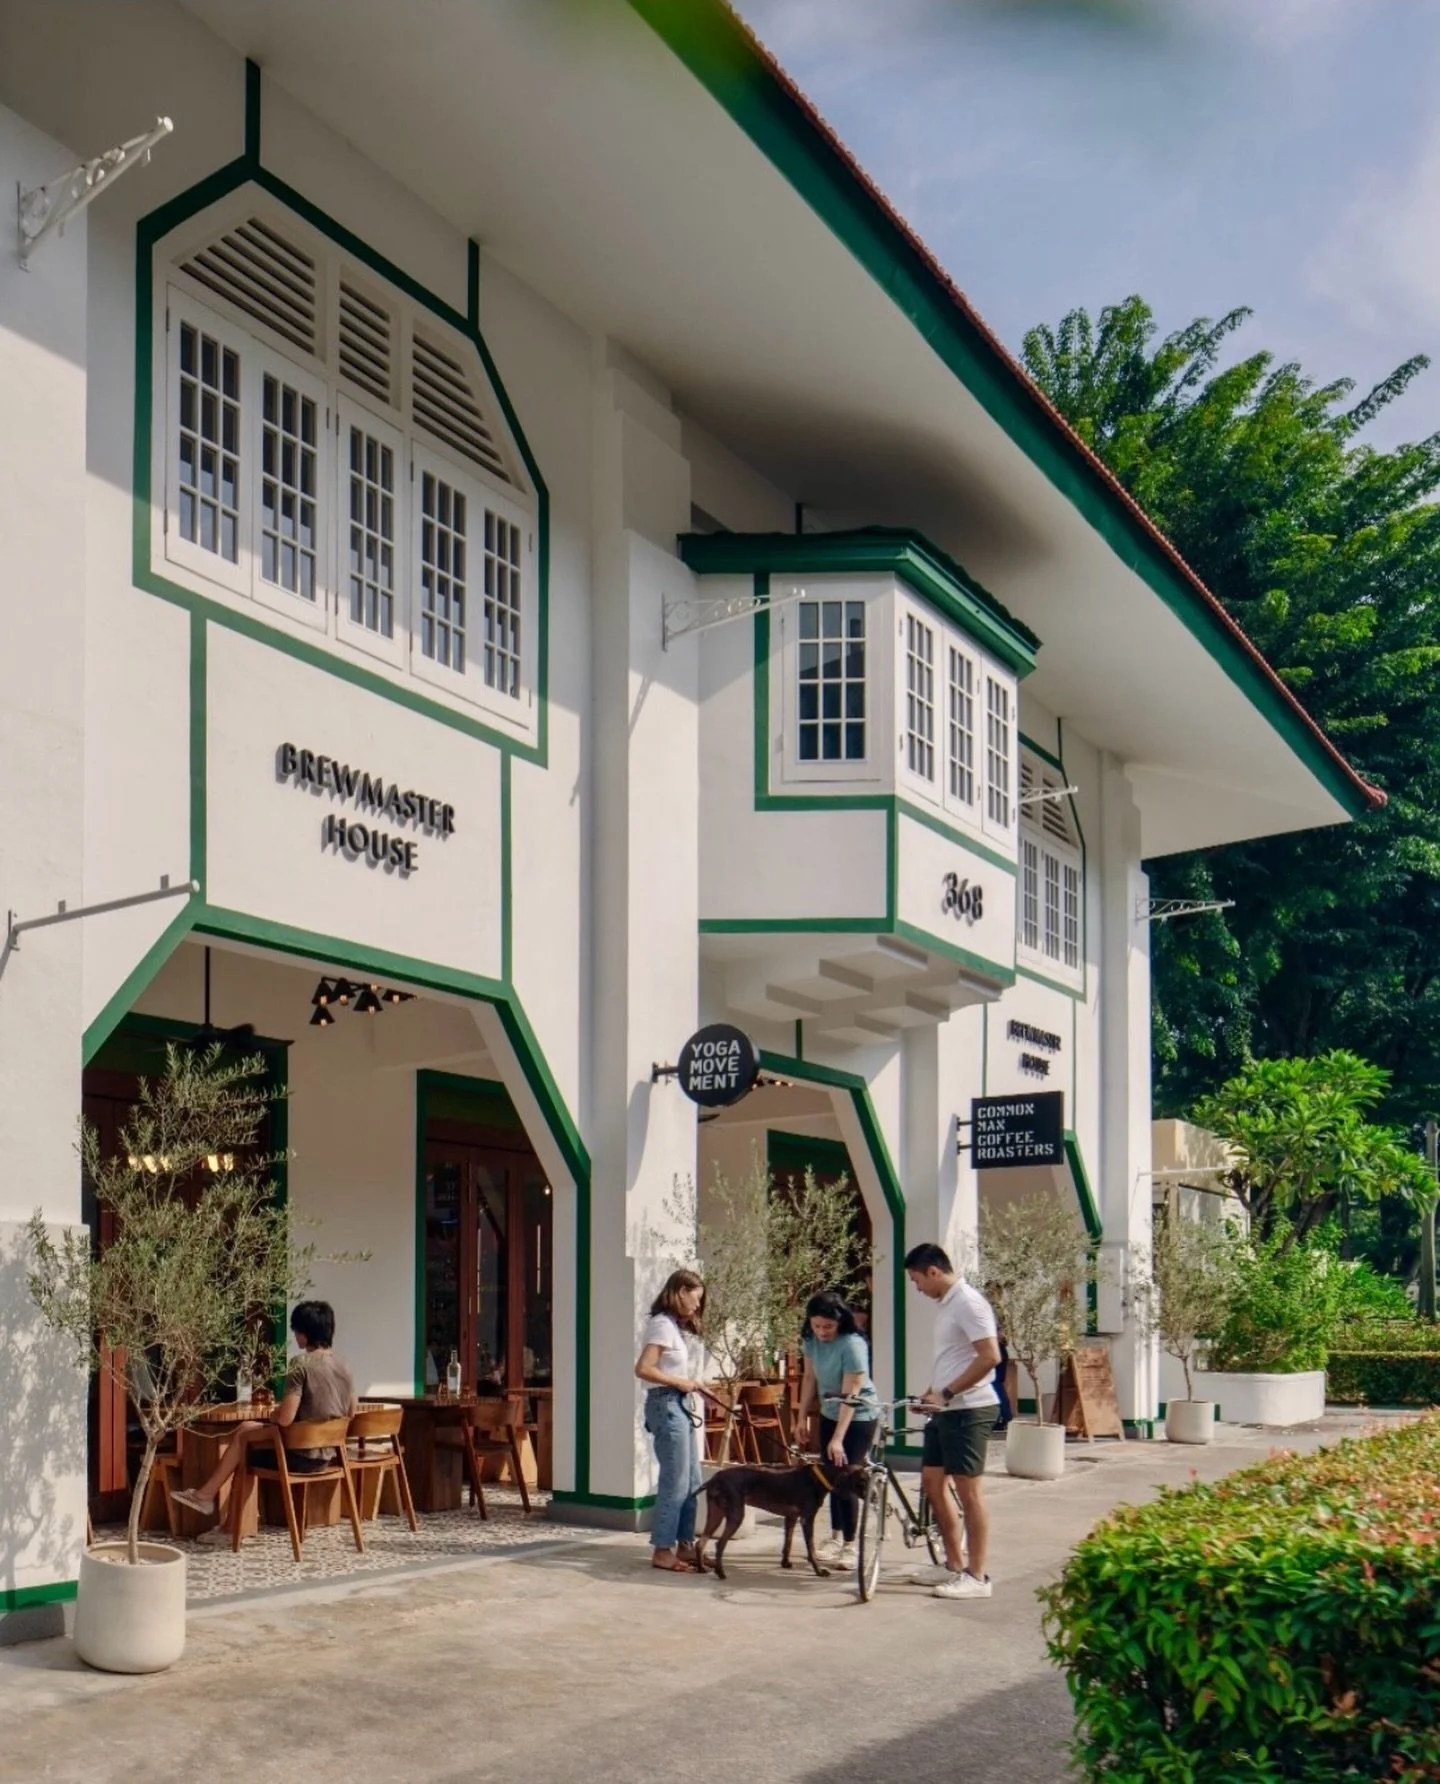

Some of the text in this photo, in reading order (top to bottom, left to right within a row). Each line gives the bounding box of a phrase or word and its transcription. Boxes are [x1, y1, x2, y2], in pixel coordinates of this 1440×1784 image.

[281, 741, 456, 834] BREWMASTER
[326, 813, 419, 873] HOUSE
[945, 871, 983, 921] 368
[691, 1039, 741, 1058] YOGA
[690, 1055, 740, 1074] MOVE
[689, 1072, 740, 1091] MENT
[977, 1103, 1035, 1120] COMMON
[977, 1131, 1035, 1147] COFFEE
[977, 1143, 1055, 1161] ROASTERS
